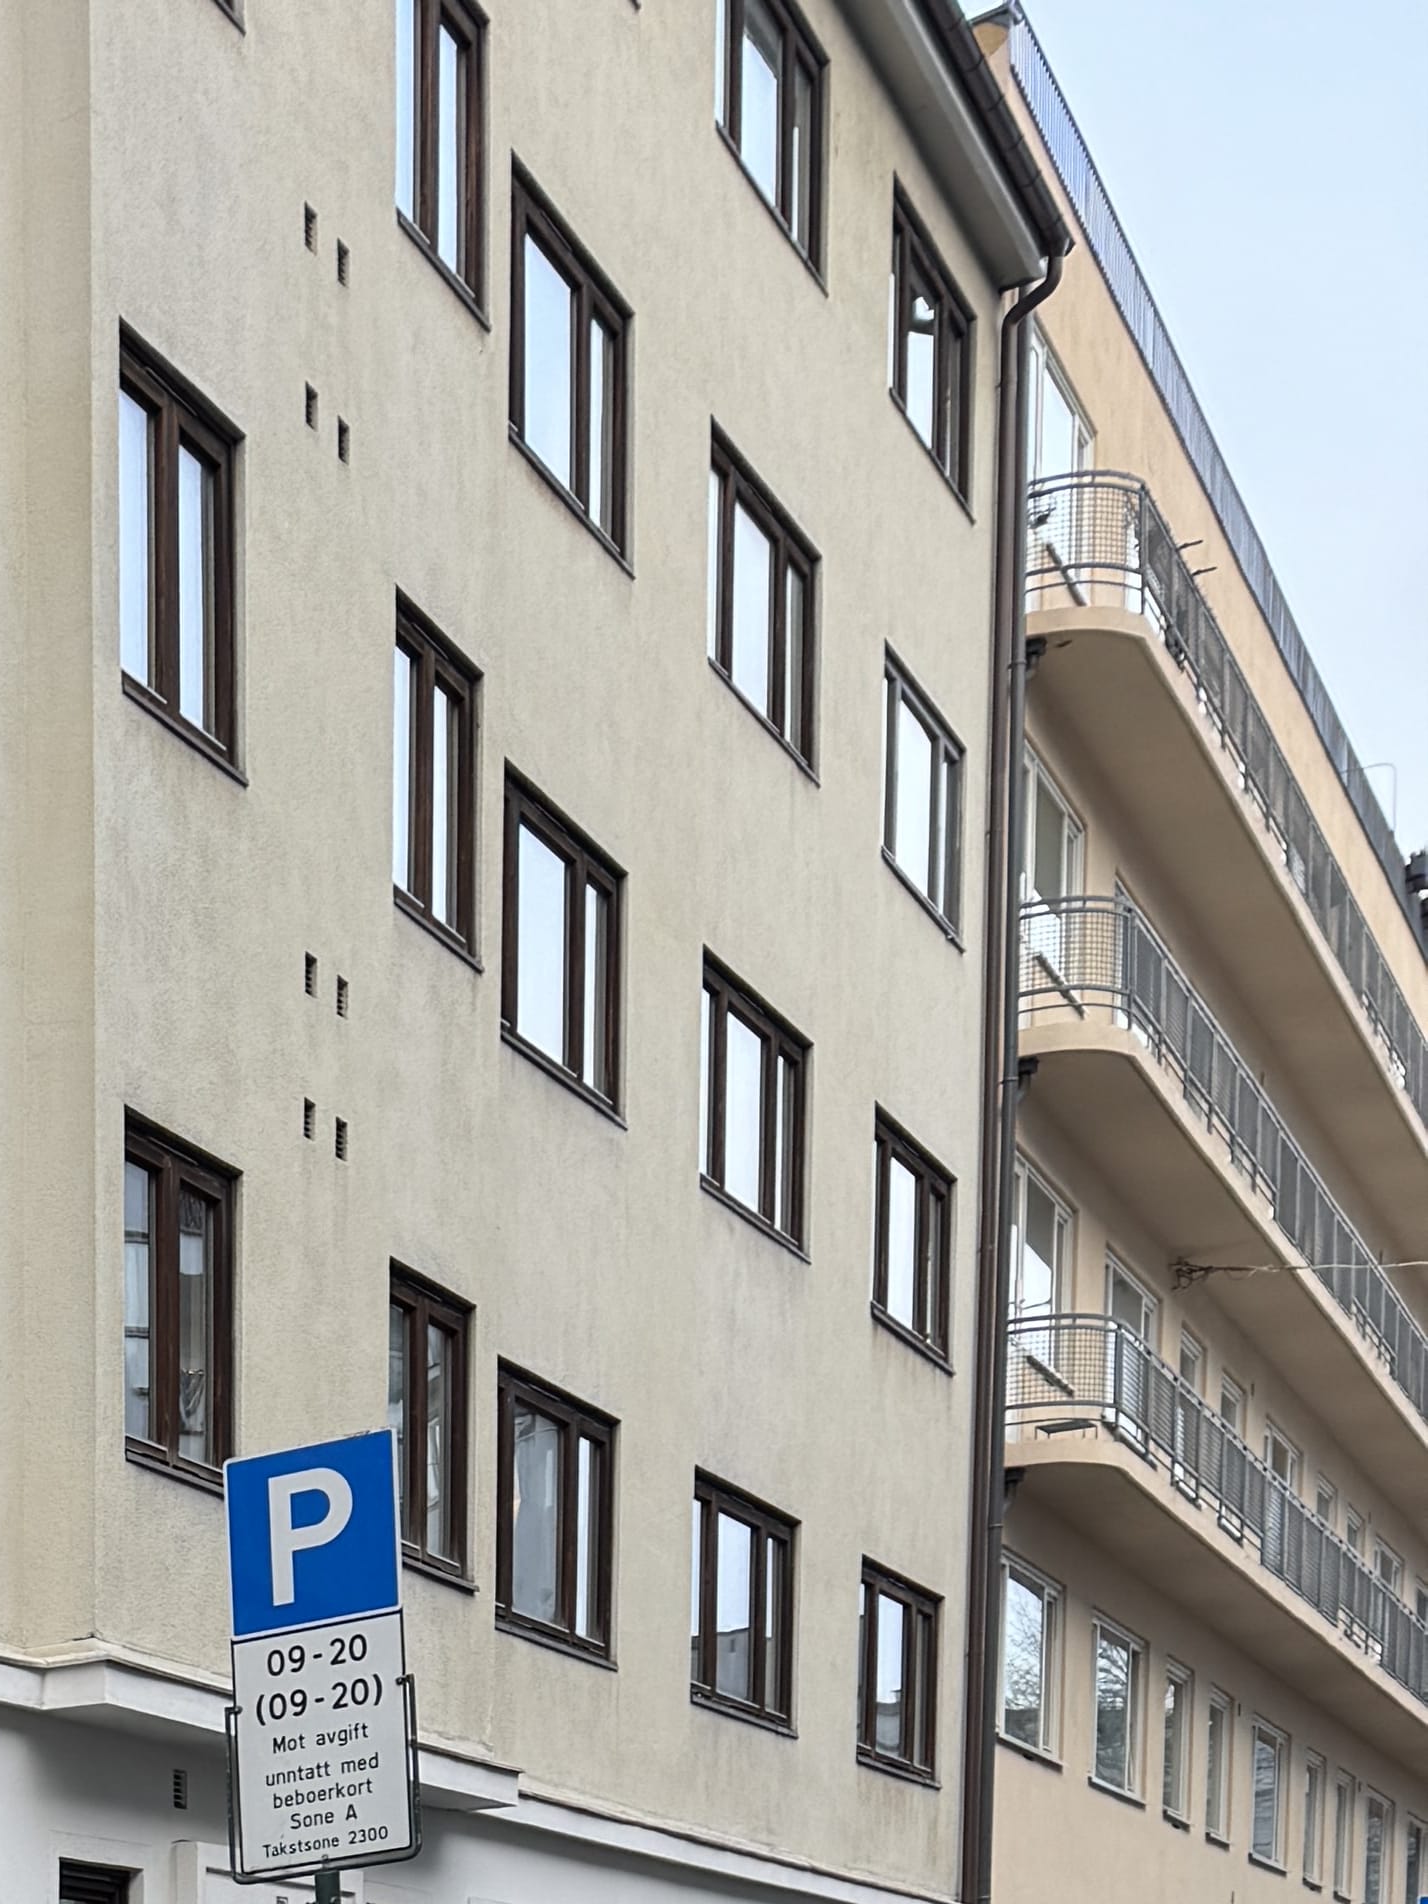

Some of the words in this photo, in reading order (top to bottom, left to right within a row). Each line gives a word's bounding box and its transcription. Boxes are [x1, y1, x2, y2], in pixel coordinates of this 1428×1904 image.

[268, 1467, 353, 1607] P
[266, 1633, 368, 1677] 09-20
[255, 1673, 384, 1727] (09-20)
[272, 1735, 307, 1755] Mot
[315, 1722, 370, 1748] avgift
[265, 1762, 333, 1788] unntatt
[340, 1753, 379, 1775] med
[272, 1778, 374, 1810] beboerkort
[290, 1809, 335, 1831] Sone
[345, 1804, 358, 1822] A
[262, 1834, 340, 1859] Takstsone
[348, 1826, 389, 1846] 2300
